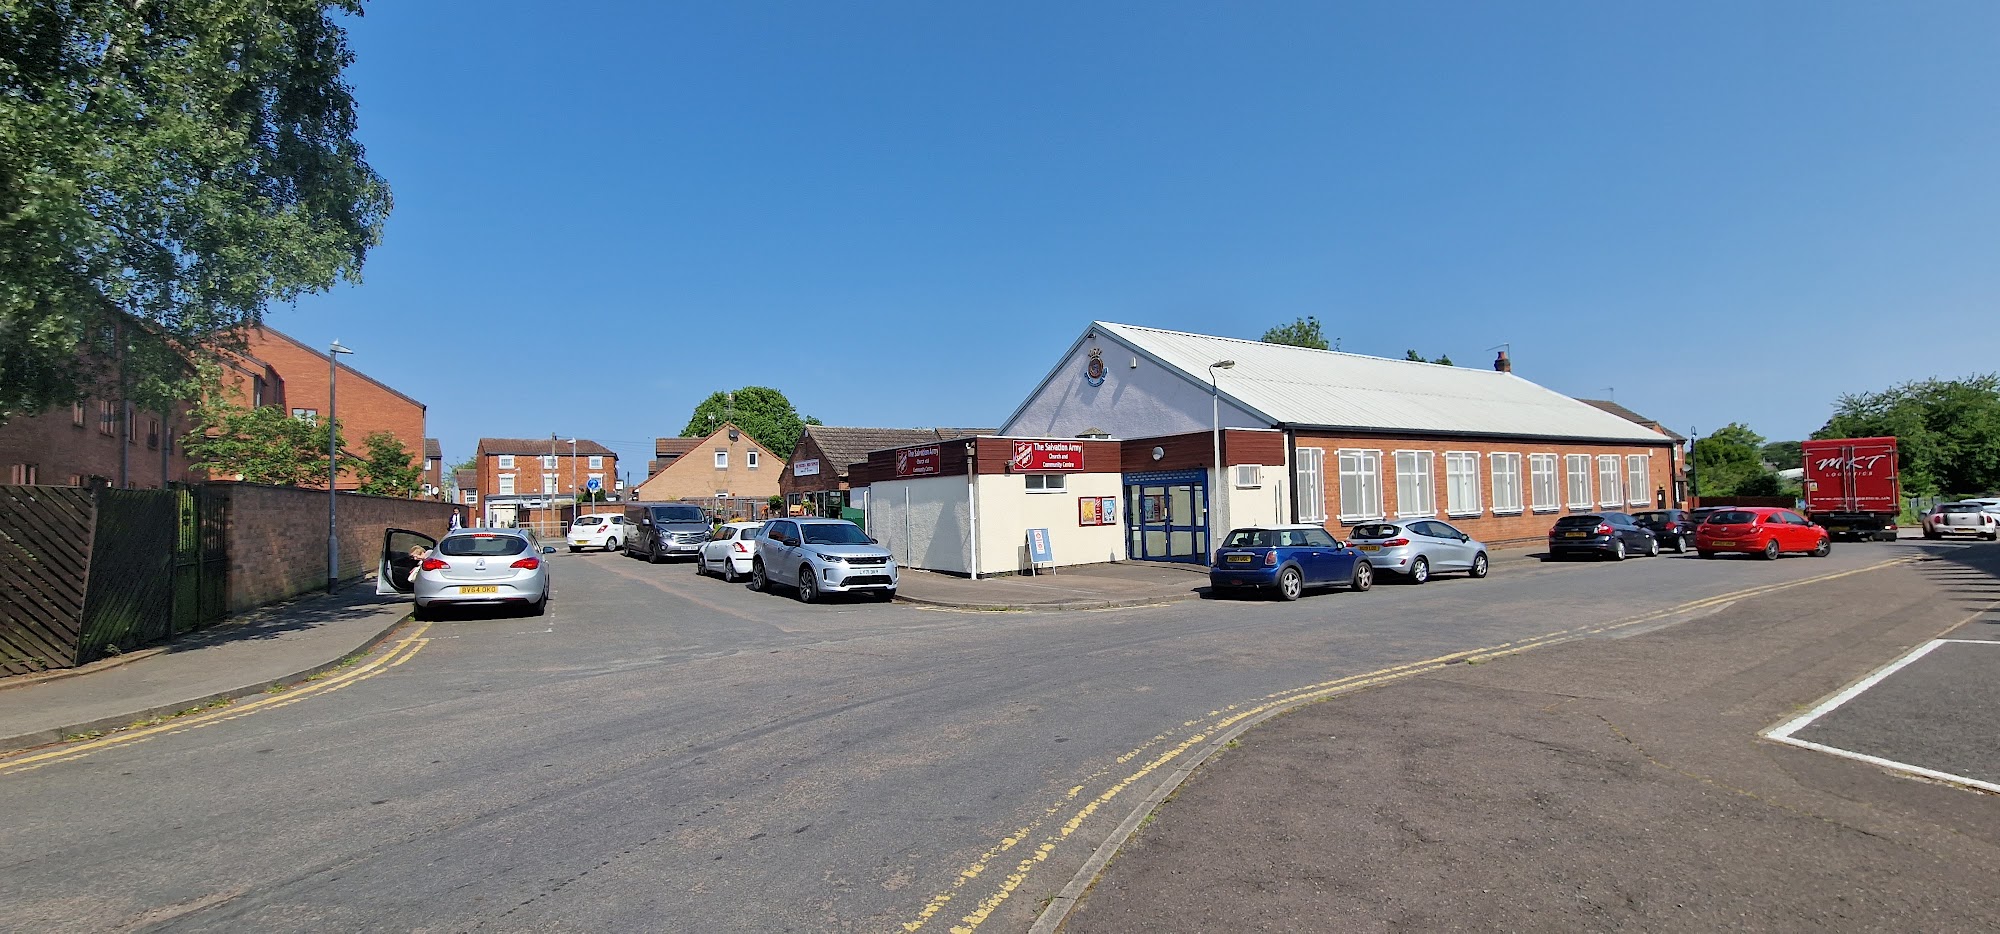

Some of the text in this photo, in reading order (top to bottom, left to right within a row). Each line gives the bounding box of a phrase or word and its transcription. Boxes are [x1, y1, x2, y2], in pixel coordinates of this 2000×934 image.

[1033, 443, 1082, 453] The Salvation Army
[1816, 455, 1886, 471] MKT
